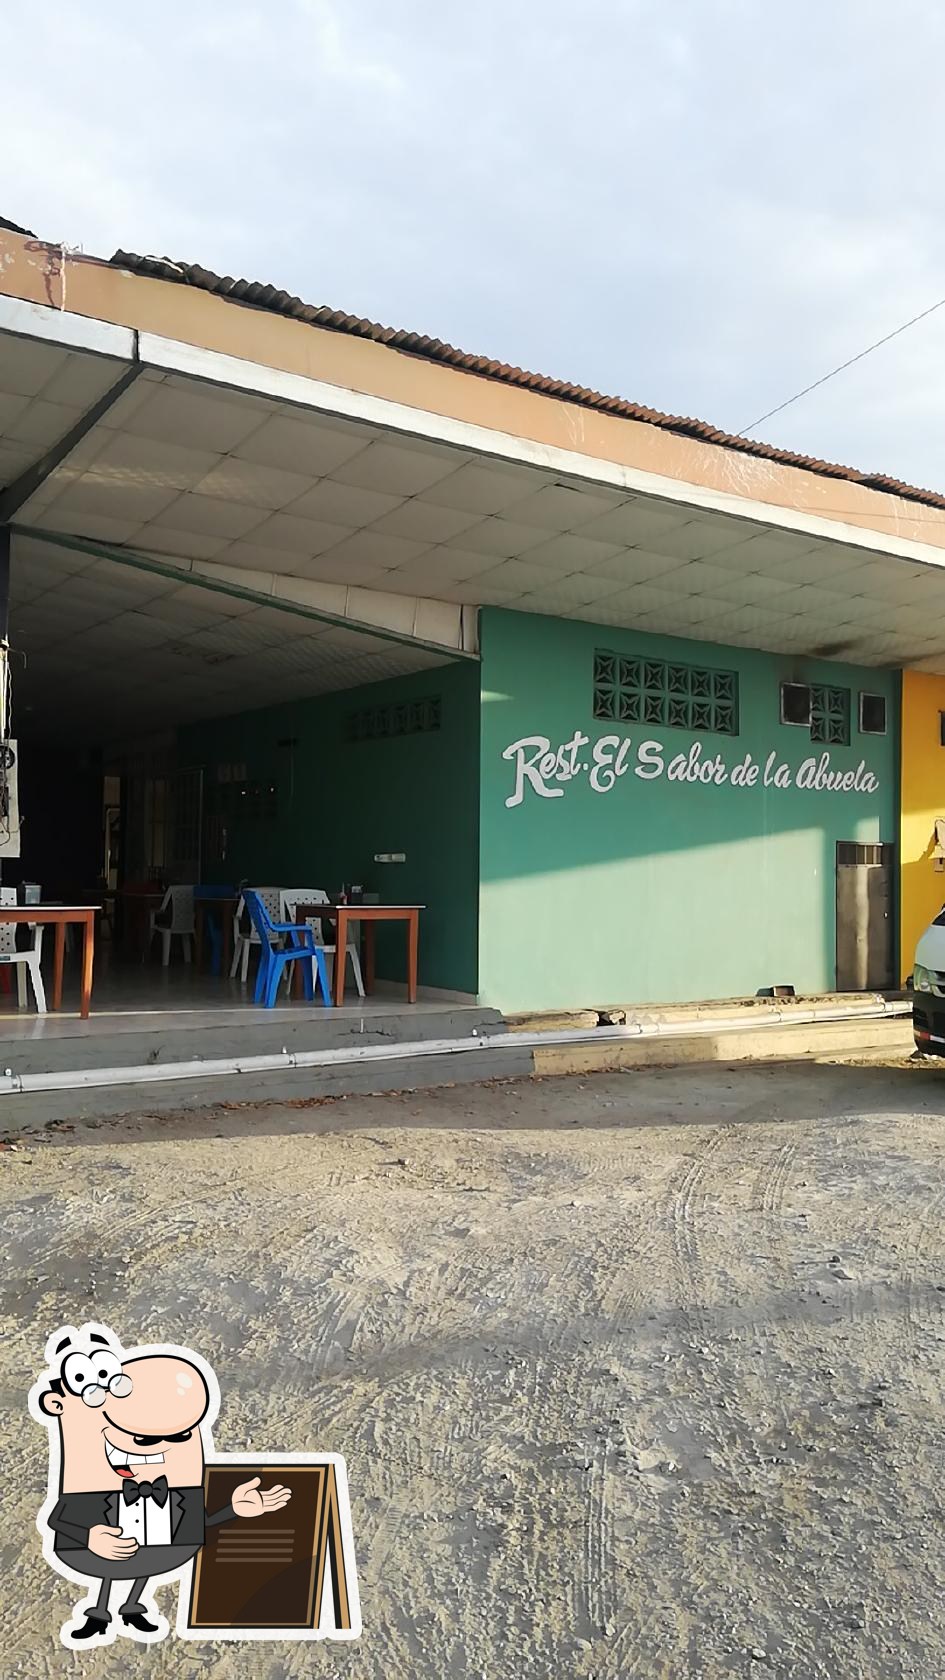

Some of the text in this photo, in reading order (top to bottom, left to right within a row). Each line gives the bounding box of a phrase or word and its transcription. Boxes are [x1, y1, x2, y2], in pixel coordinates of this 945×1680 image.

[502, 731, 589, 808] Rest.
[589, 735, 632, 793] El
[634, 740, 728, 785] Sabor
[730, 753, 758, 786] de
[763, 751, 792, 790] la
